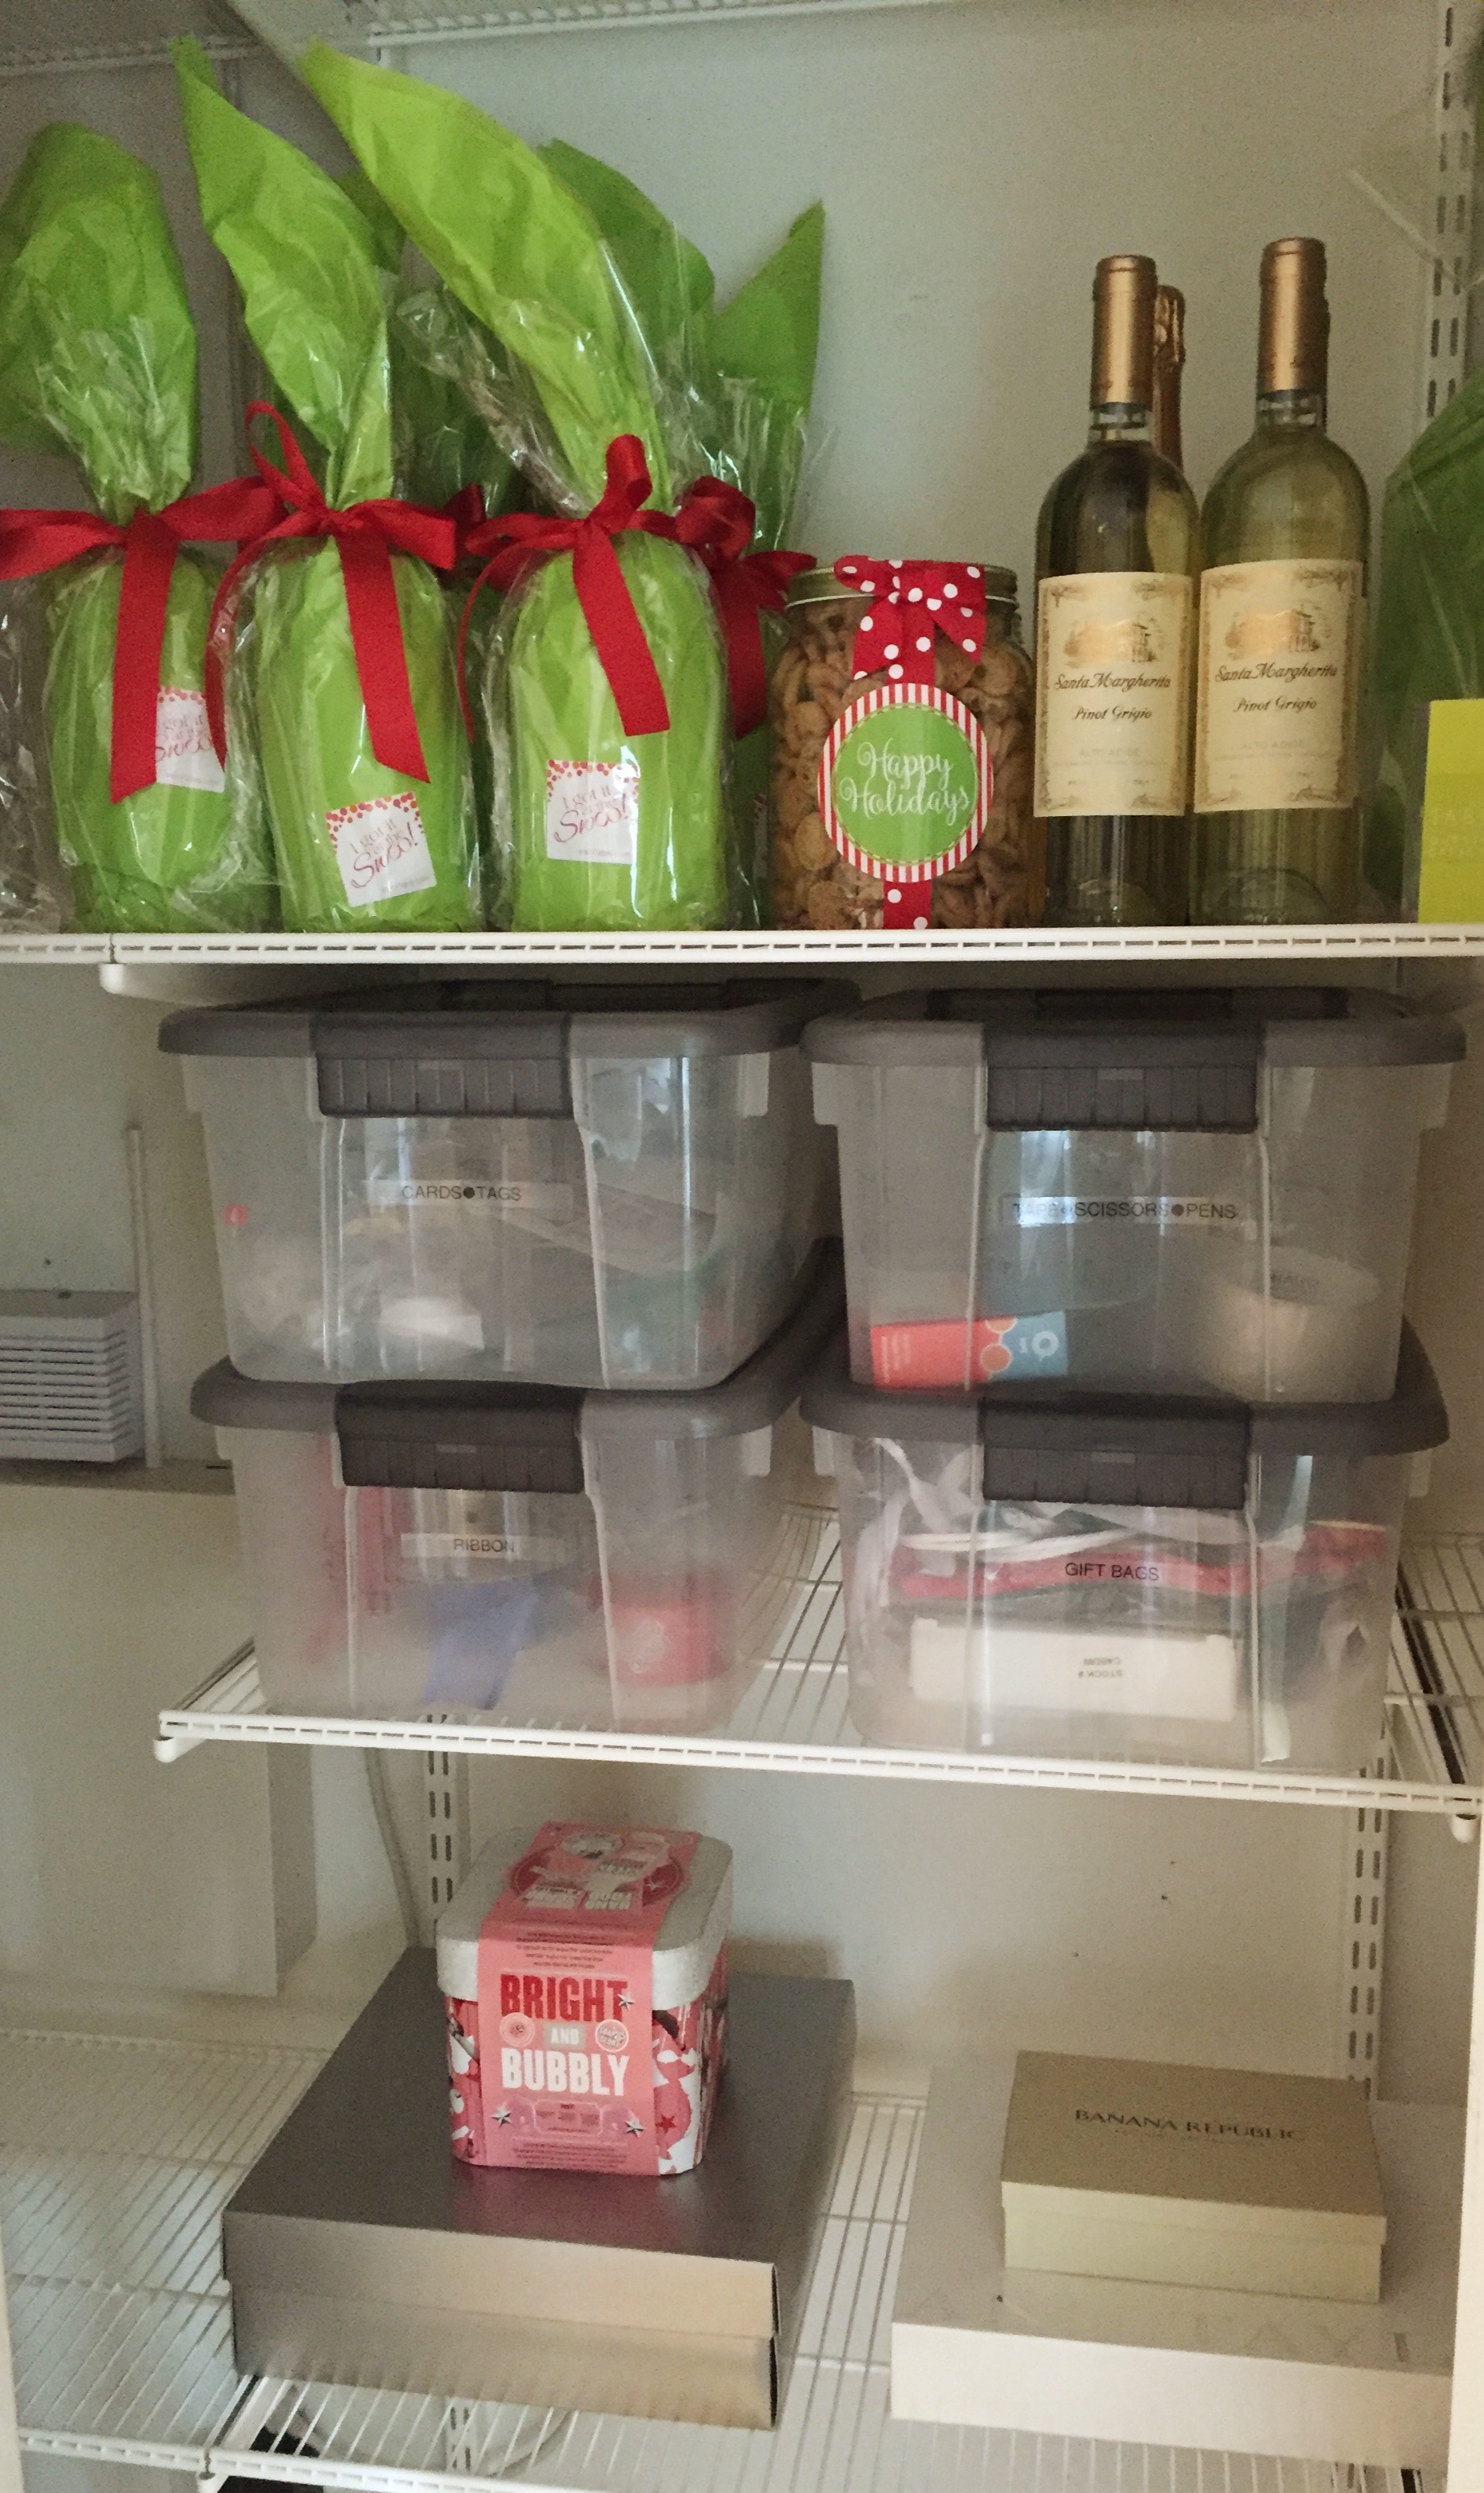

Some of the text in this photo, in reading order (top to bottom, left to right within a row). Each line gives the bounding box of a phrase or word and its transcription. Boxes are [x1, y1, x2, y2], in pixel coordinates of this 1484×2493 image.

[1054, 671, 1172, 692] Santa Margherita
[1214, 662, 1338, 683] Santa Margherita
[1073, 705, 1153, 723] Pinot Grigio
[1233, 696, 1317, 713] Pinot Grigio
[857, 738, 954, 791] Happy
[840, 777, 970, 826] Holidays
[453, 1538, 515, 1553] RIBBON
[1065, 1562, 1160, 1581] GIFT BAGS
[501, 1973, 628, 2023] BRIGHT
[550, 2027, 580, 2046] AND
[501, 2047, 630, 2096] BUBBLY
[1075, 2110, 1177, 2131] BANANA
[1186, 2121, 1301, 2139] REPUBLIC
